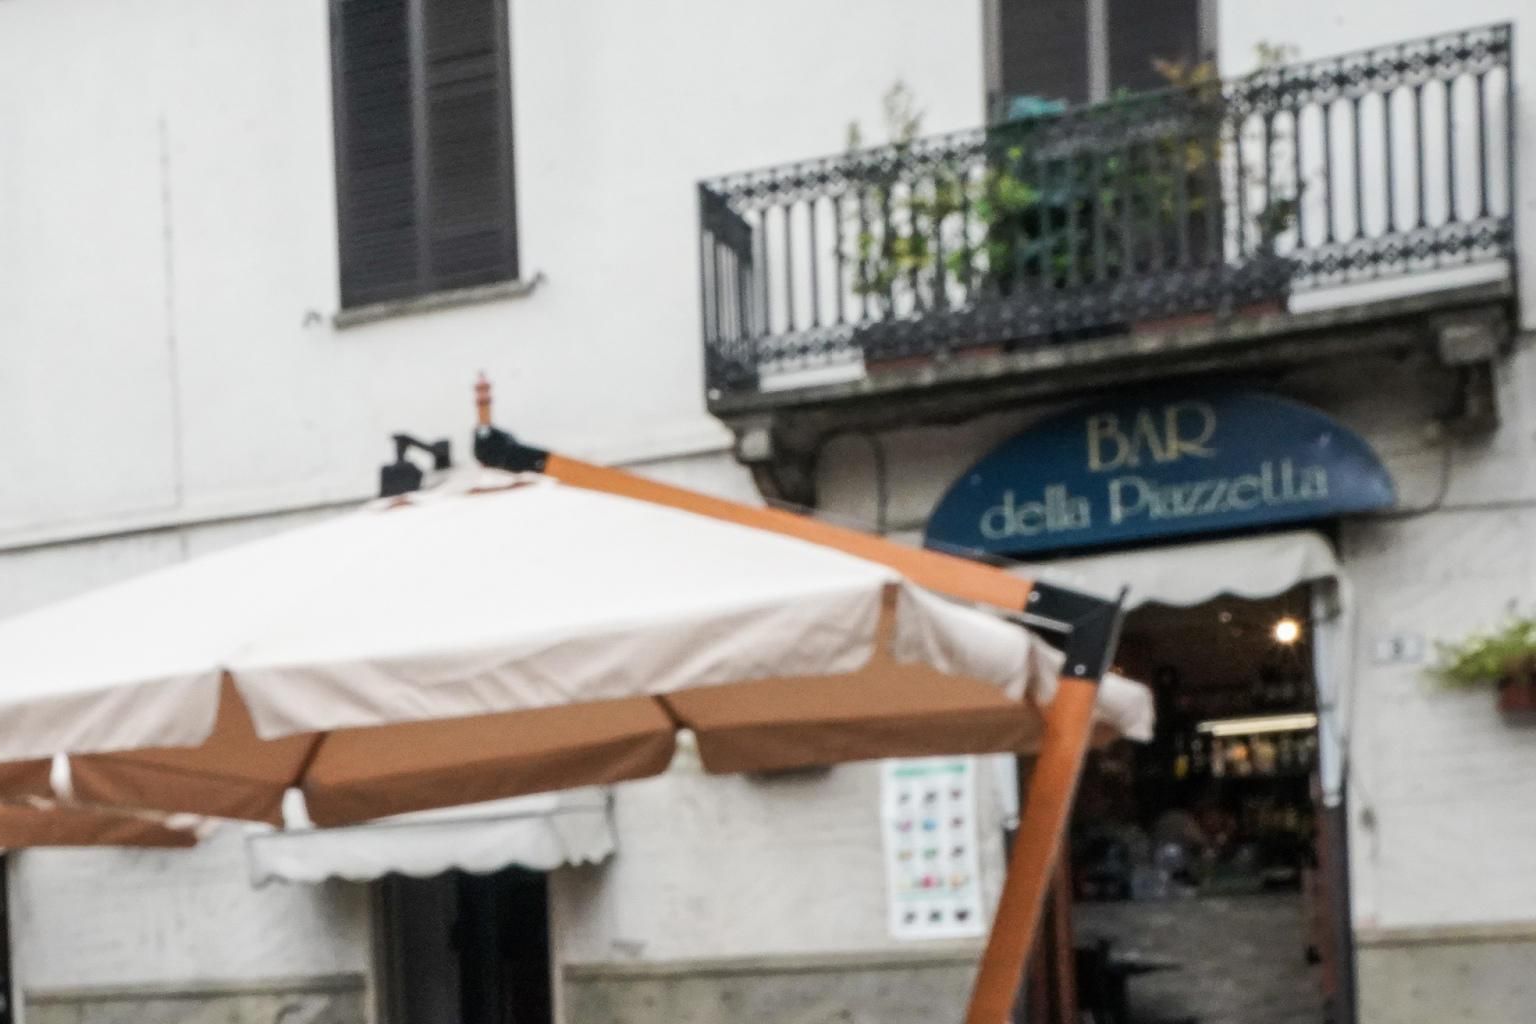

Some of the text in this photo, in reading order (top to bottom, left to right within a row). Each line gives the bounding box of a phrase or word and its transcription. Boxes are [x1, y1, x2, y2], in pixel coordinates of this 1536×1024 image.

[1086, 403, 1218, 473] BAR
[979, 458, 1330, 540] della Piazzetta
